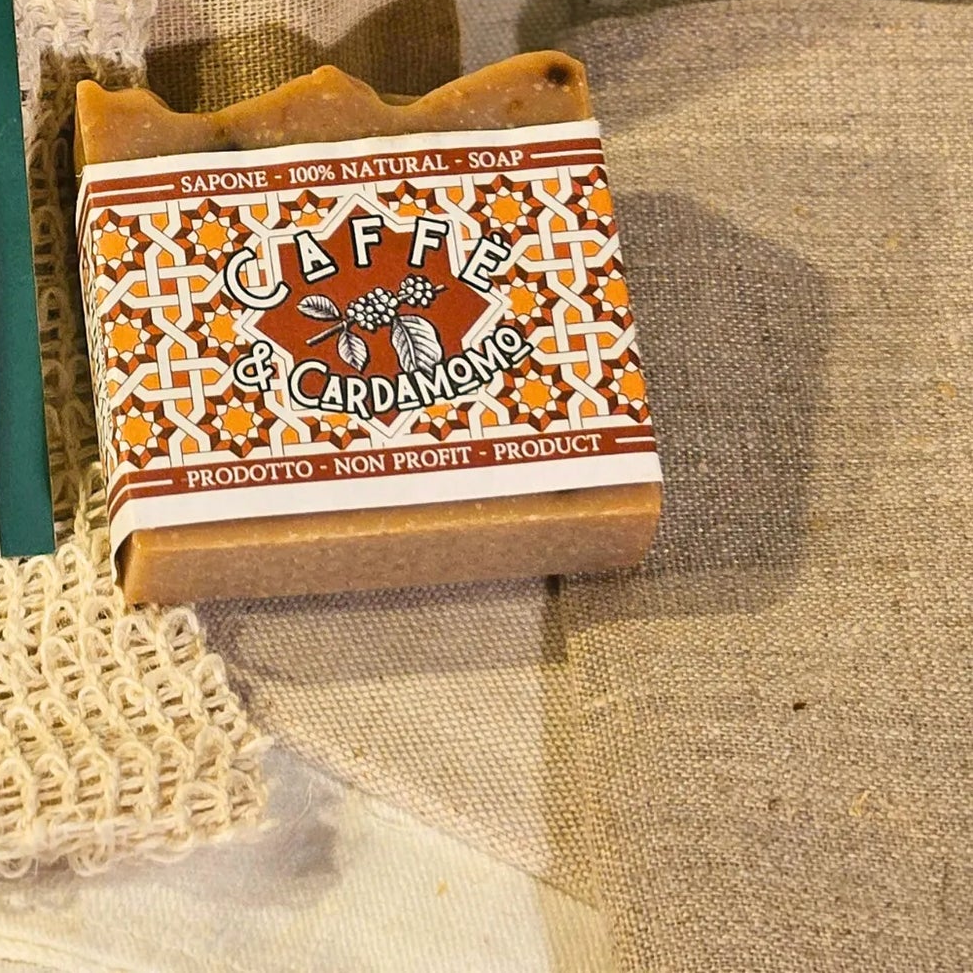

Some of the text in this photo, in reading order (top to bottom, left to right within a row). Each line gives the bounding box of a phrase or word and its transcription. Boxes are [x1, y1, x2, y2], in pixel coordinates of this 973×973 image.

[180, 169, 268, 194] SAPONE
[289, 161, 336, 184] 100%
[340, 153, 448, 181] NATURAL
[468, 149, 524, 169] SOAP
[233, 339, 274, 391] &
[187, 460, 313, 488] PRODOTTO
[334, 453, 389, 475] NON
[393, 446, 472, 472] PROFIT
[493, 434, 603, 458] PRODUCT
